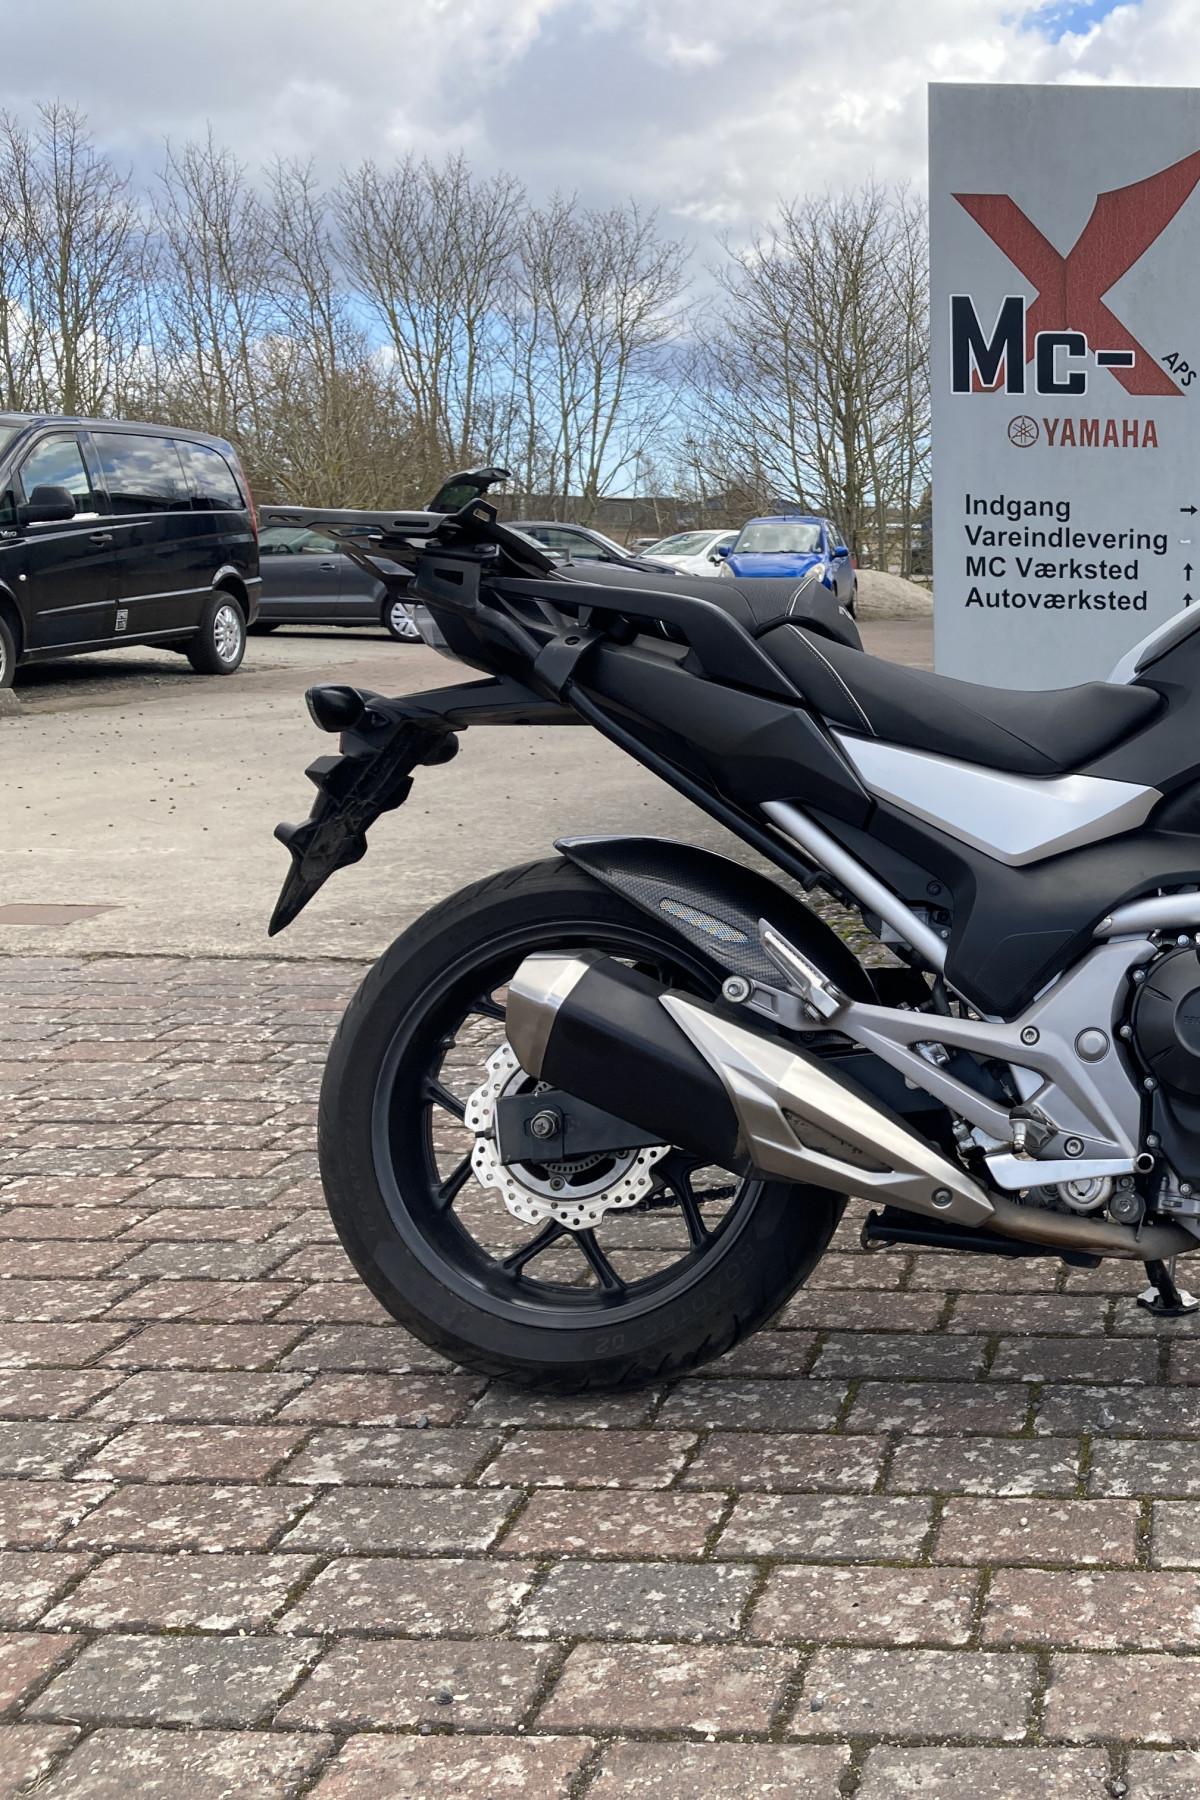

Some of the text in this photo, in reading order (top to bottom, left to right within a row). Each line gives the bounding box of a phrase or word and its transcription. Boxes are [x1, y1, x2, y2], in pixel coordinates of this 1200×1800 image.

[1161, 351, 1197, 387] APS
[1042, 417, 1159, 449] YAMAHA
[964, 493, 1071, 523] Indgang
[964, 525, 1168, 555] Vareindlevering
[965, 556, 1139, 580] MC Værksted
[964, 586, 1148, 611] Autoværksted
